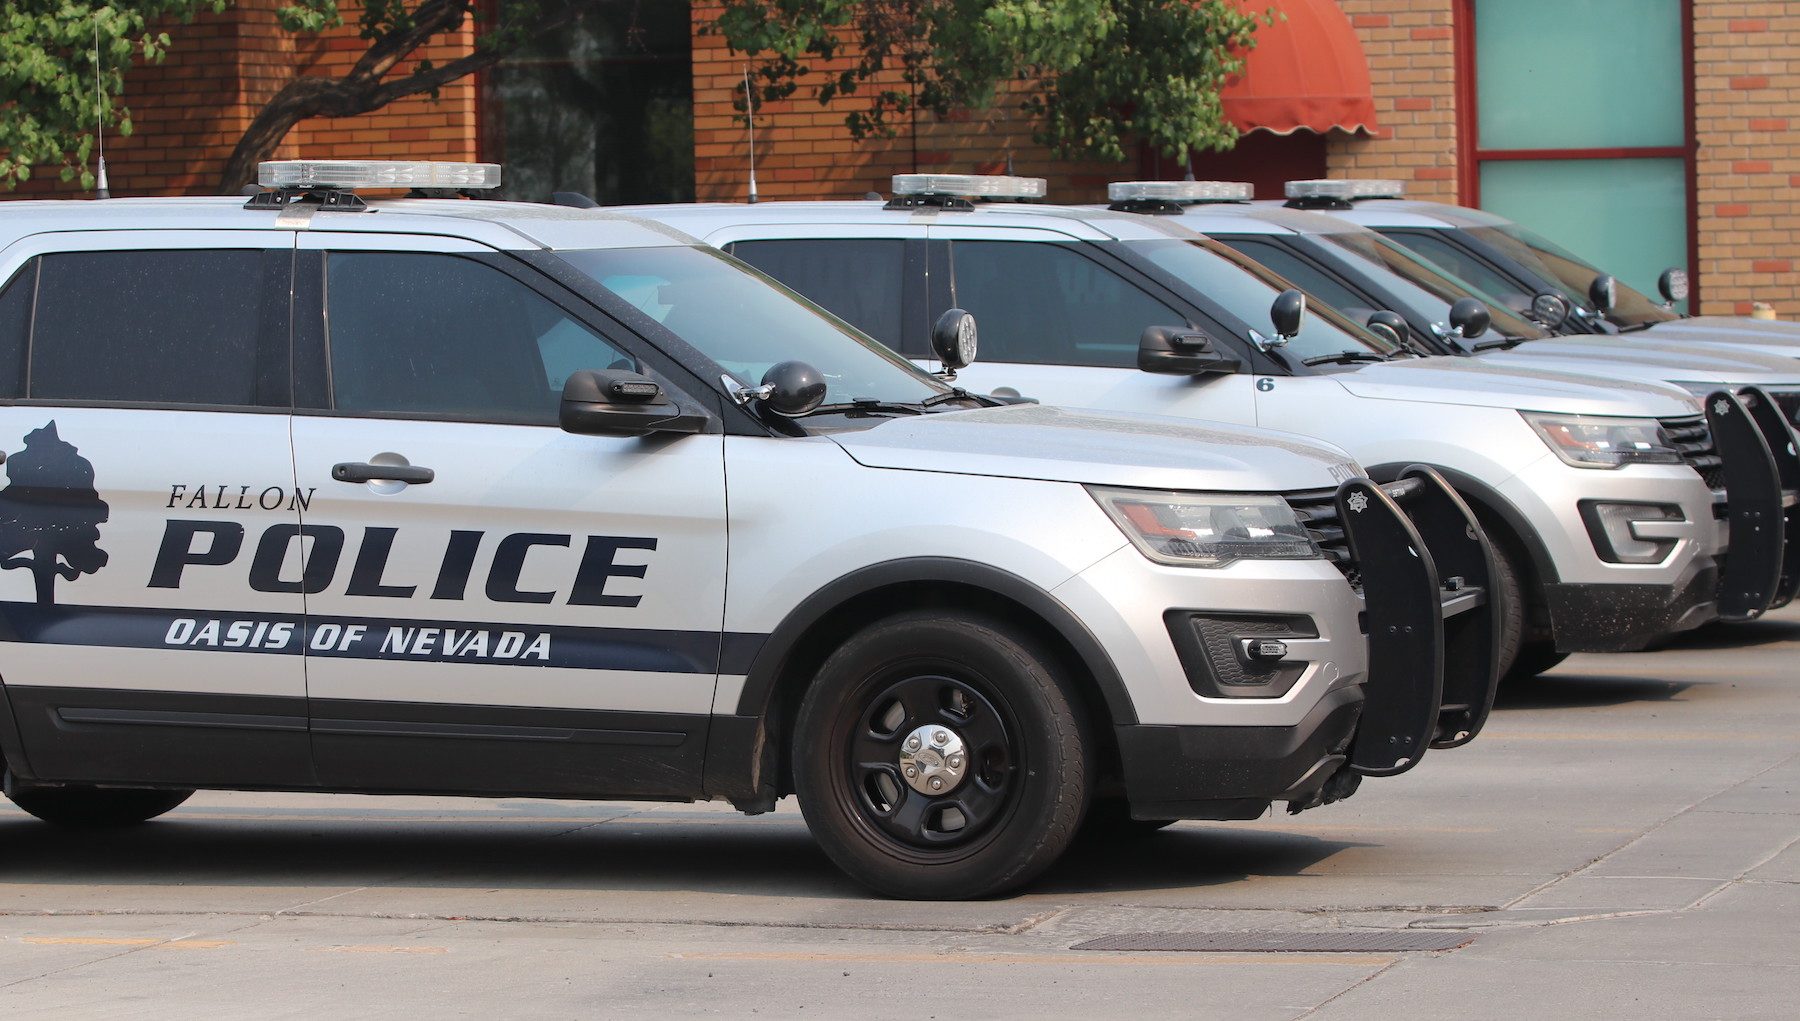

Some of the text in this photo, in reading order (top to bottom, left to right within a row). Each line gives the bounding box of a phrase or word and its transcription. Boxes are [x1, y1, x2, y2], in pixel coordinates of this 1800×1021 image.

[1256, 377, 1275, 392] 6
[166, 485, 316, 511] FALLON
[147, 519, 657, 607] POLICE
[165, 618, 552, 660] OASIS OF NEVADA
